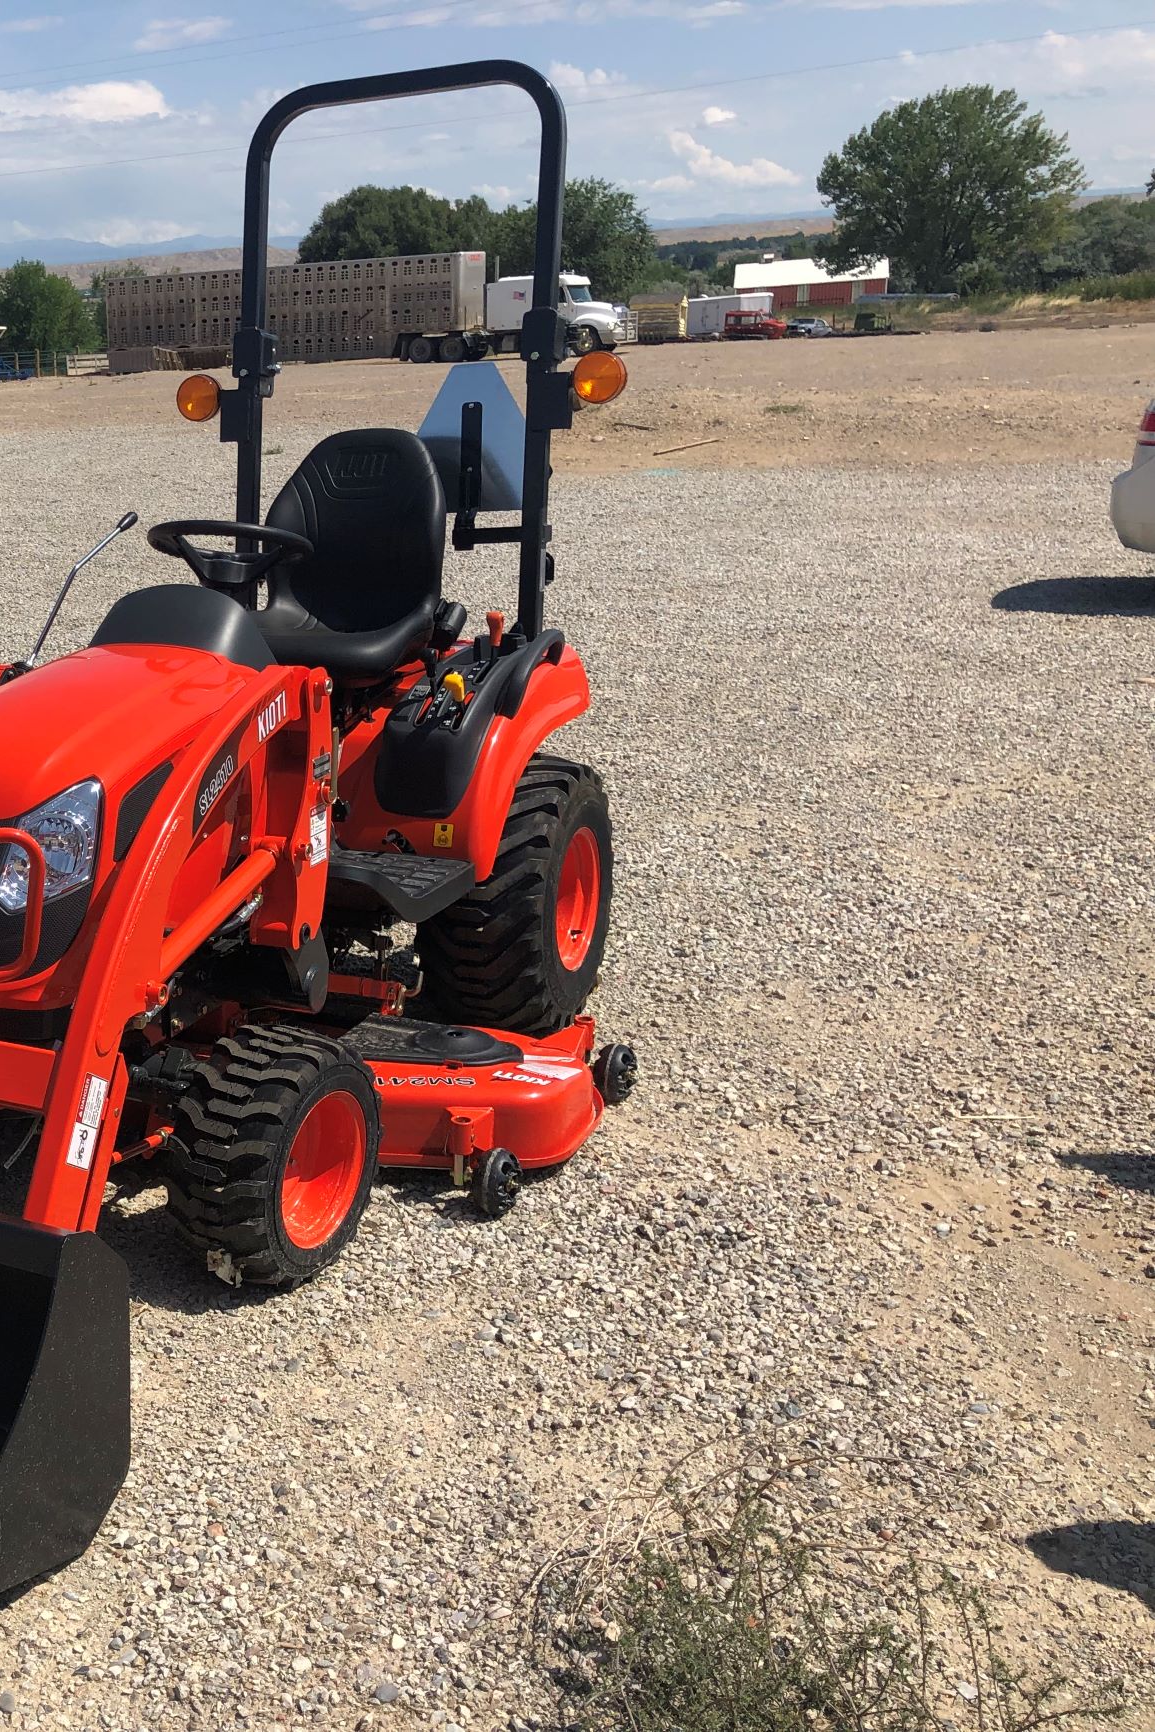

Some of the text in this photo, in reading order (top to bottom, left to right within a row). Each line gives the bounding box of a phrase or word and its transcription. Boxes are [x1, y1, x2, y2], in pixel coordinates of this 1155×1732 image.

[257, 689, 286, 743] KIOTI
[198, 754, 234, 816] SL2410
[79, 1078, 91, 1111] DANGER
[374, 1076, 476, 1087] SM241
[492, 1070, 551, 1086] KIOTI
